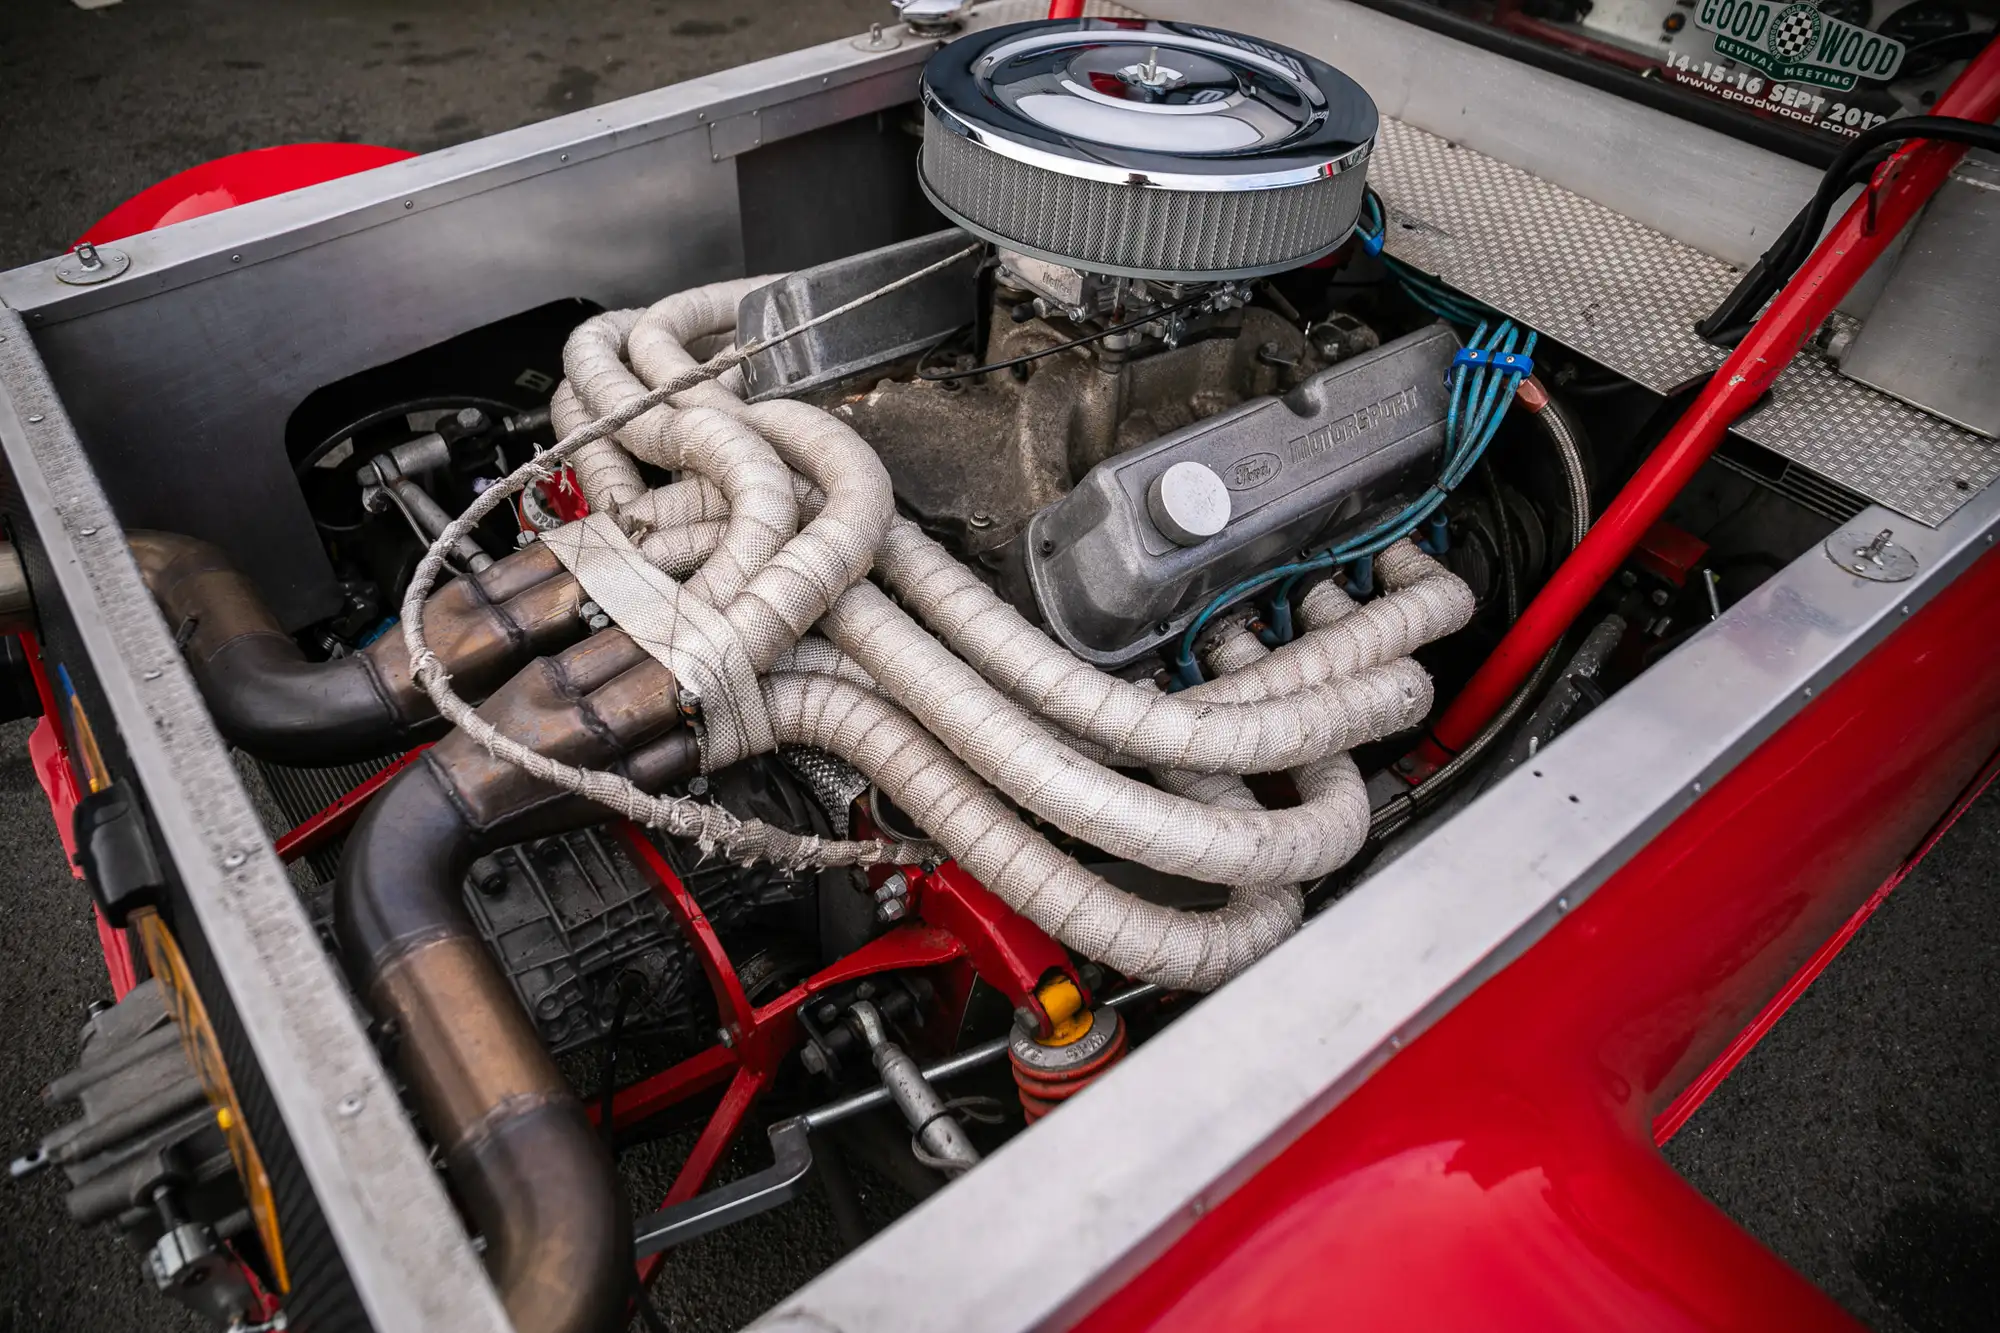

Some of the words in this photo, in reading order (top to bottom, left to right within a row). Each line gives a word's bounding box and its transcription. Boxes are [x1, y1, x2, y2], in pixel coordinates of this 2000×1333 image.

[1701, 0, 1770, 42] GOOD
[1816, 20, 1900, 77] WOOD
[1719, 40, 1774, 72] REVIVAL
[1783, 67, 1851, 87] MEETING
[1676, 72, 1861, 139] www.goodwood.com
[1768, 84, 1826, 114] SEPT
[1233, 459, 1271, 487] Ford
